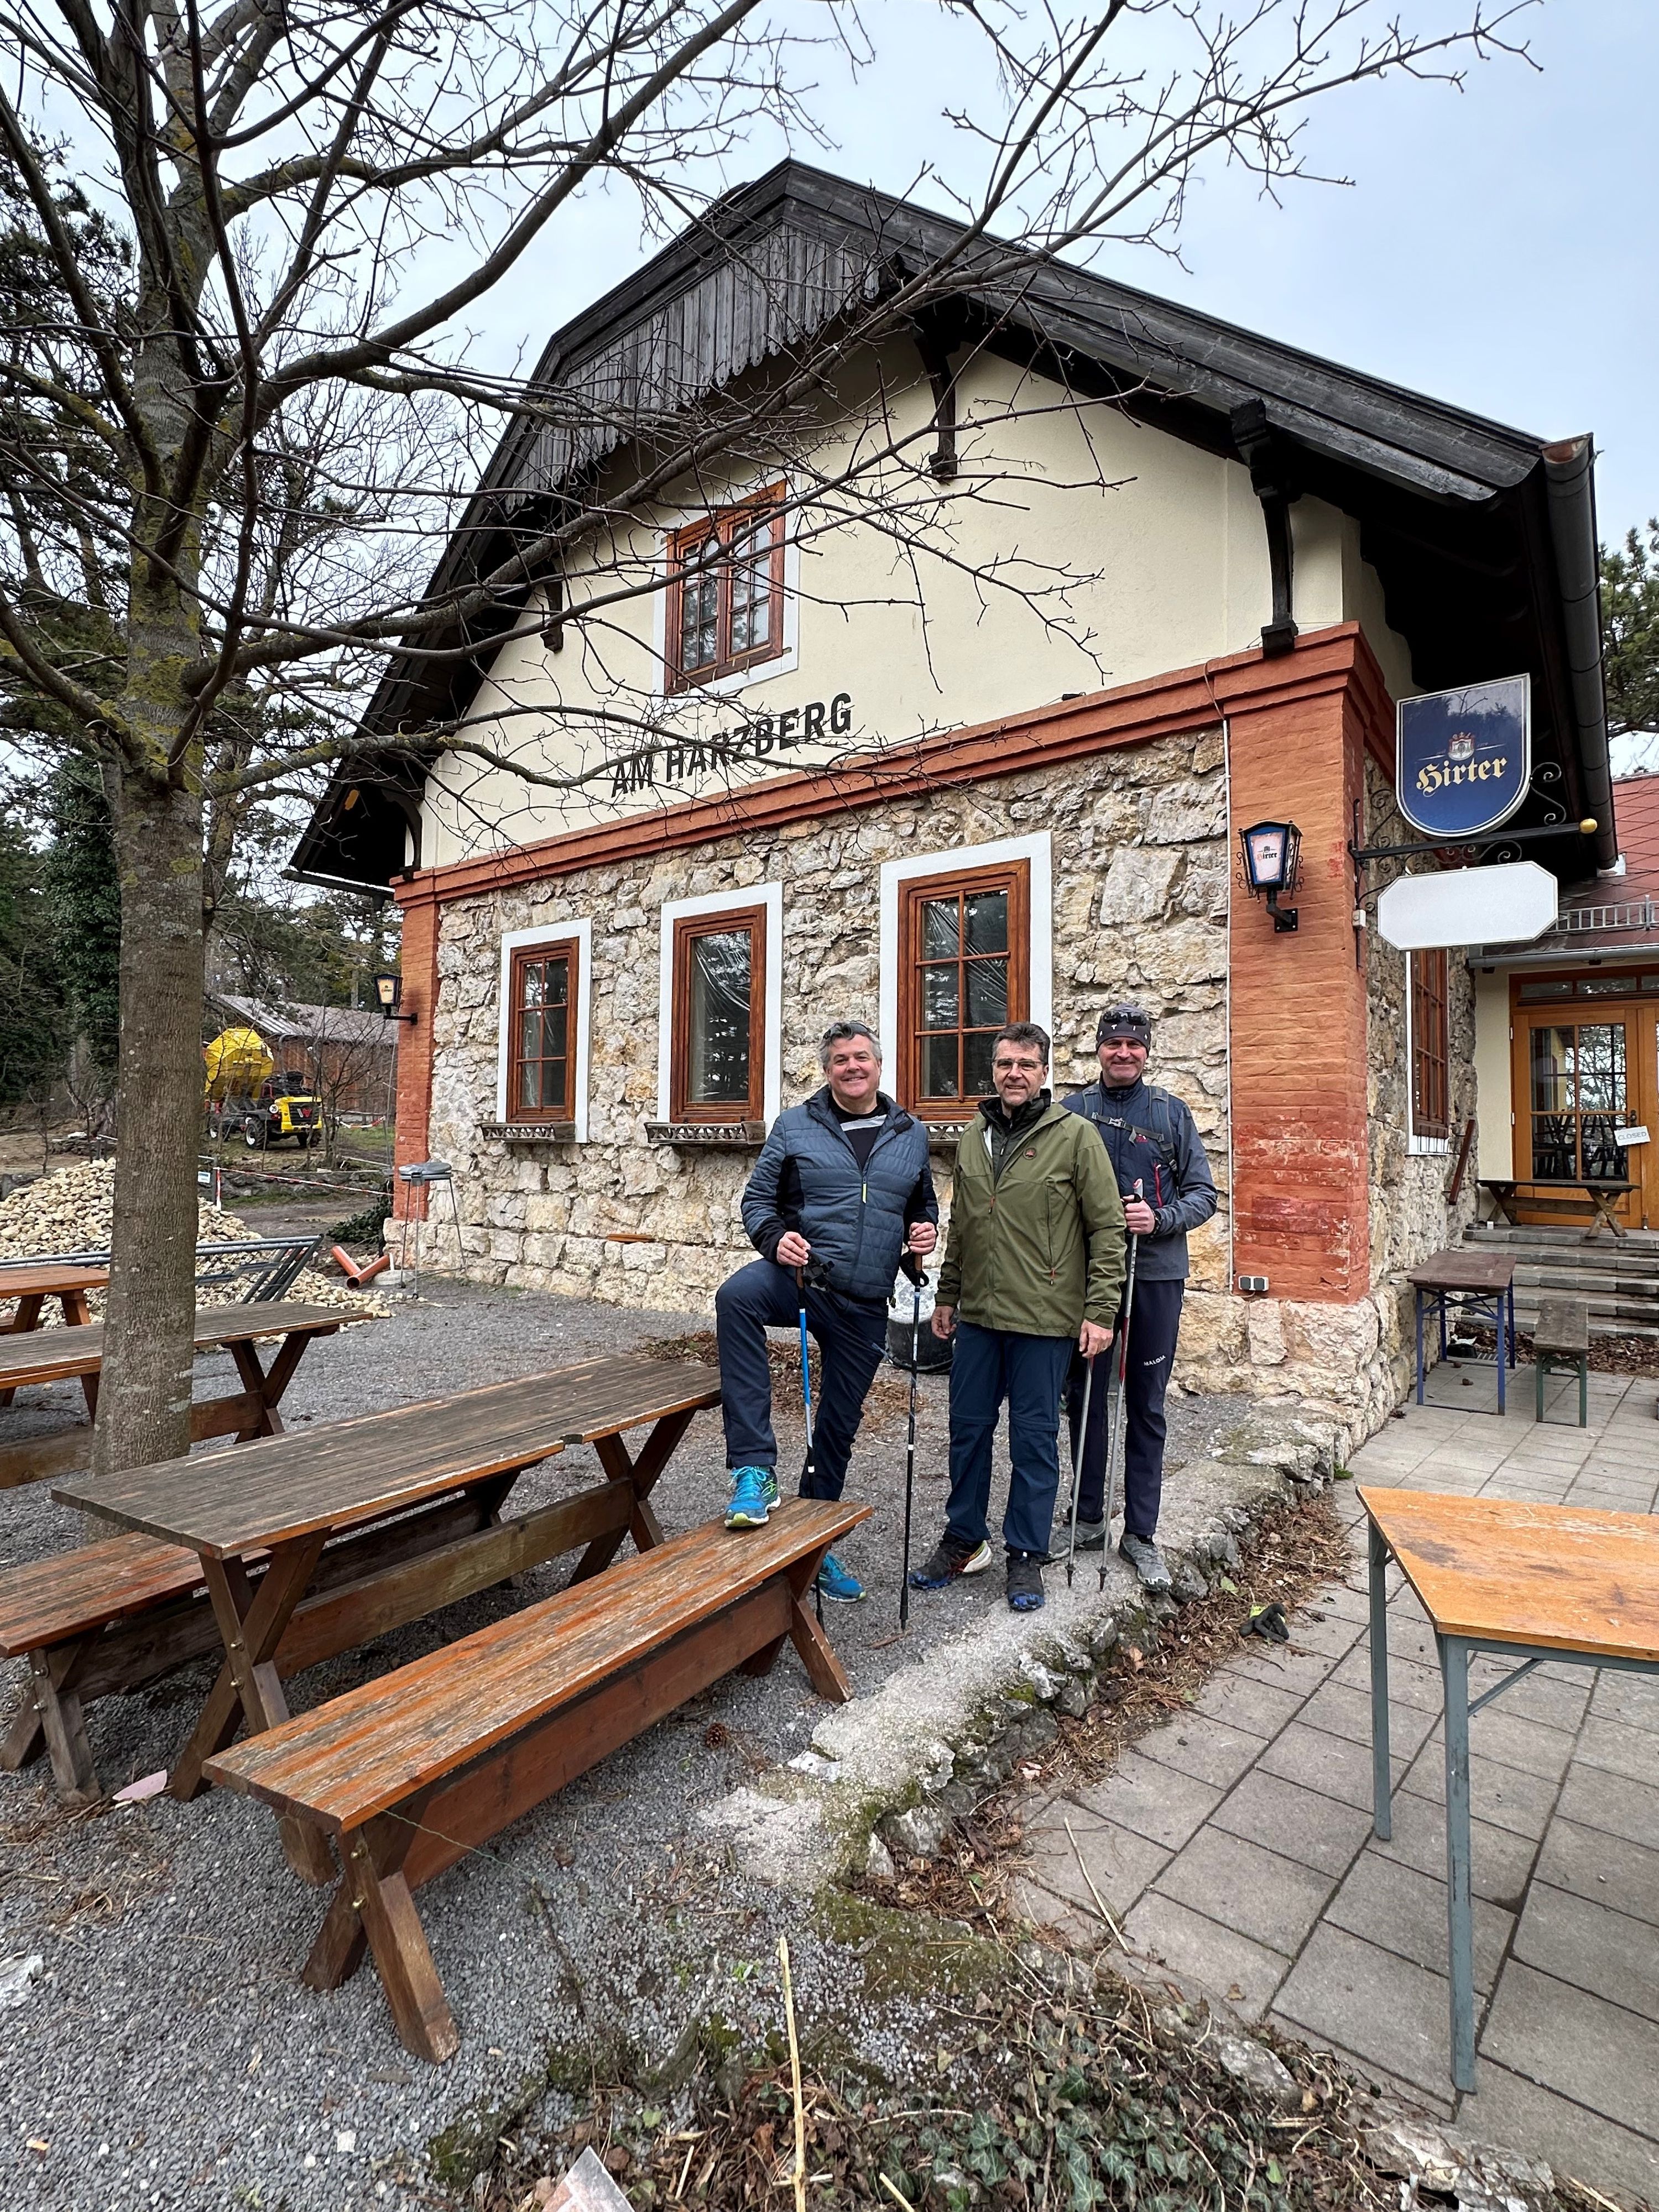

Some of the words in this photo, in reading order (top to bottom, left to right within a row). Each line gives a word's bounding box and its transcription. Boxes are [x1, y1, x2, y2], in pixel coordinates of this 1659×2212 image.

[612, 750, 653, 797] AM
[666, 692, 852, 782] HARZBERG
[1416, 758, 1507, 797] Hirter
[1618, 1131, 1647, 1140] CLOSED
